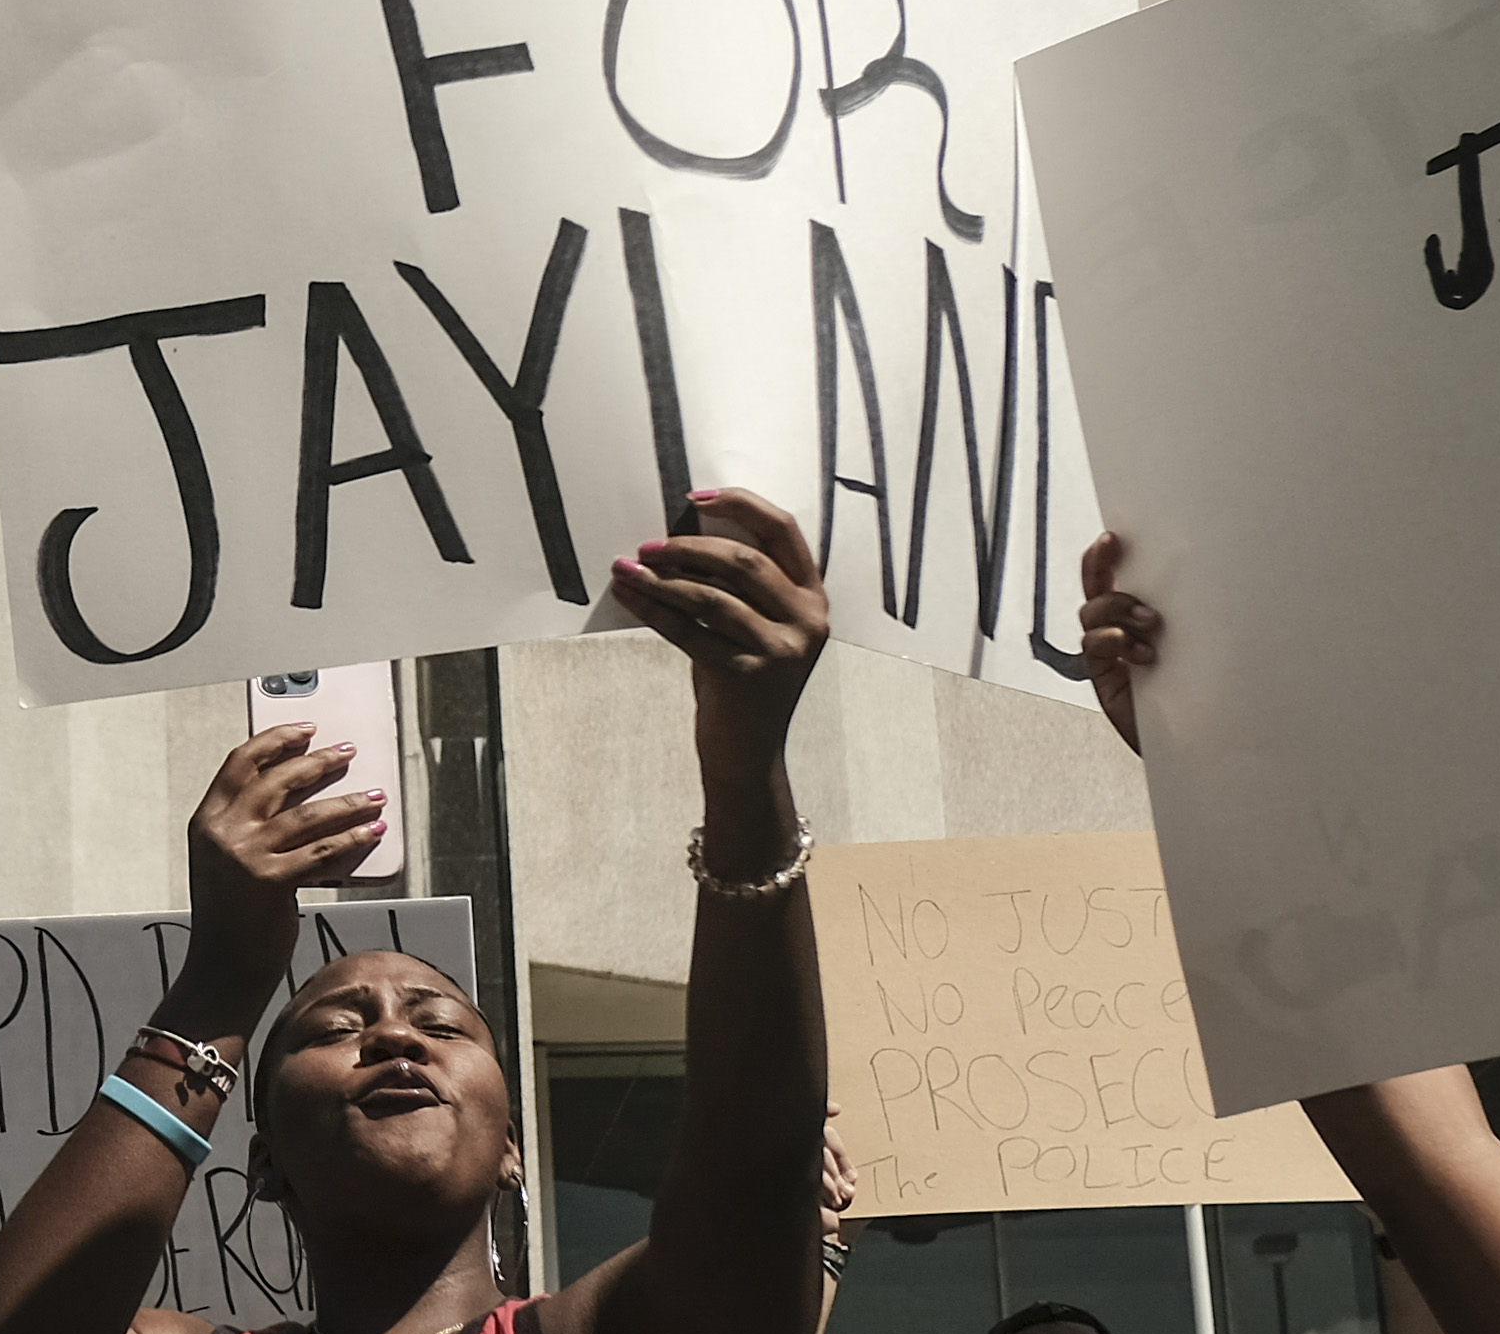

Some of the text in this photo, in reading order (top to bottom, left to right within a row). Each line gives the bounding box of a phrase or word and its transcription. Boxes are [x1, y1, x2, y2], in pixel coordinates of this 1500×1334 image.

[858, 883, 949, 966] NO
[876, 979, 965, 1035] NO
[853, 1135, 1239, 1204] The POLICE
